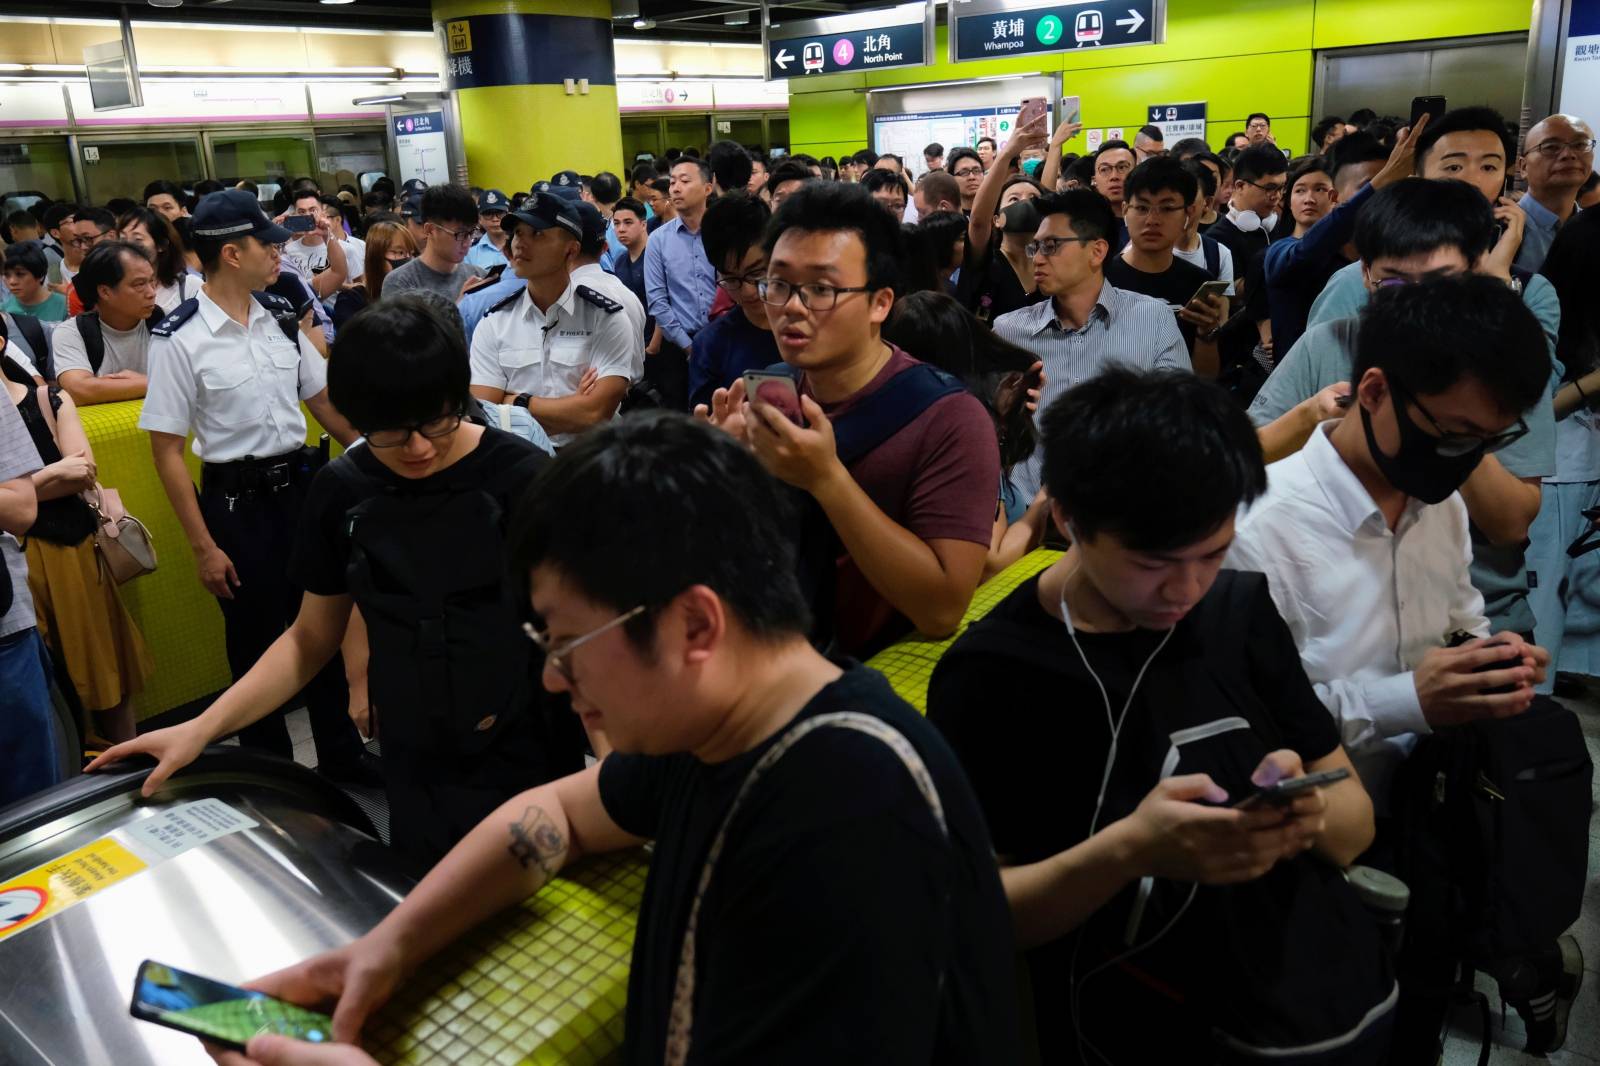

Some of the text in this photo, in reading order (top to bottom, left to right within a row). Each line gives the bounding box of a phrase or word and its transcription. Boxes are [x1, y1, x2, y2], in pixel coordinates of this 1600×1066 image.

[992, 18, 1025, 40] 黃埔
[1043, 20, 1056, 40] 2
[863, 33, 891, 53] 北角
[984, 40, 1024, 51] Whampoa
[837, 44, 848, 61] 4
[863, 52, 903, 64] North Point
